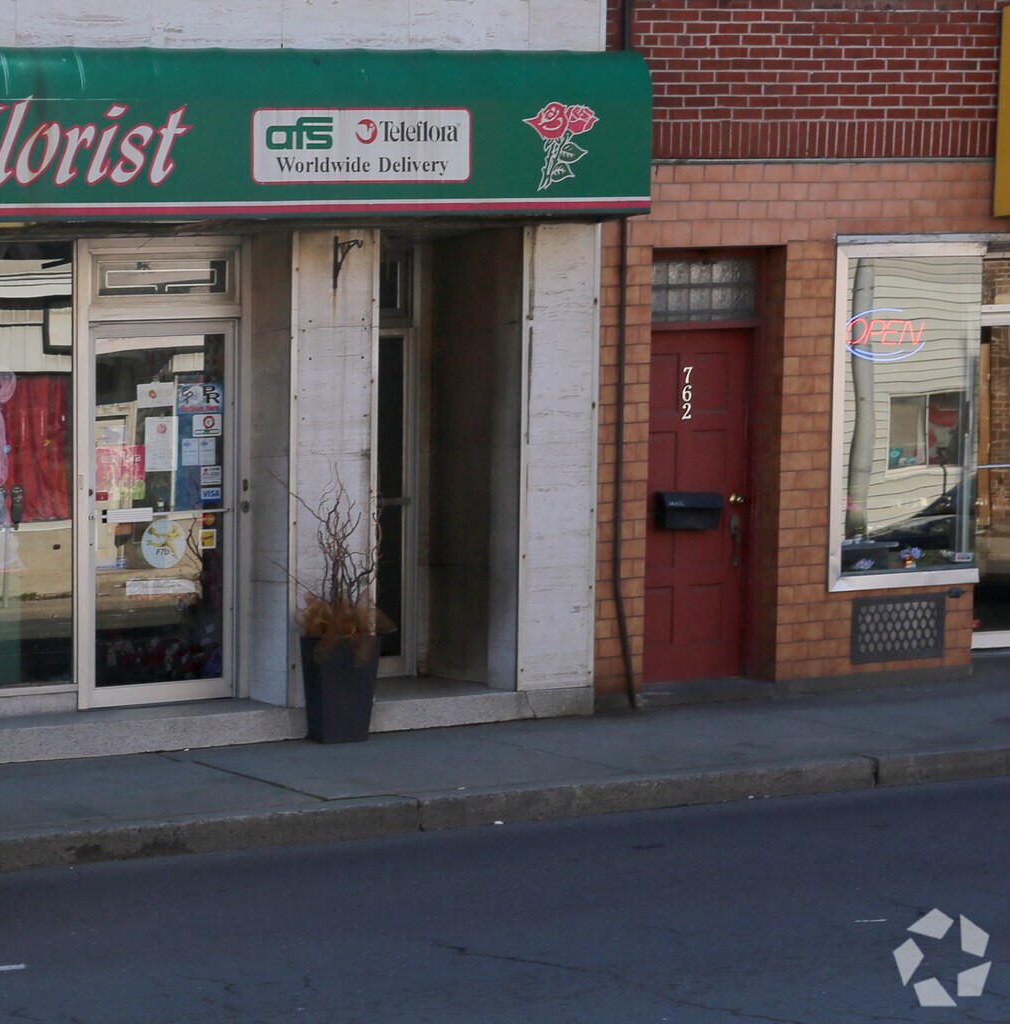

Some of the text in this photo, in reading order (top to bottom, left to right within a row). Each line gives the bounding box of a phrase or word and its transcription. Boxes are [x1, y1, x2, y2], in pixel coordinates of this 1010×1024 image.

[265, 116, 458, 150] afs Teleflora
[276, 155, 449, 176] Worldwide Delivery
[846, 318, 925, 346] OPEN
[681, 366, 693, 421] 762
[155, 548, 170, 556] FTD
